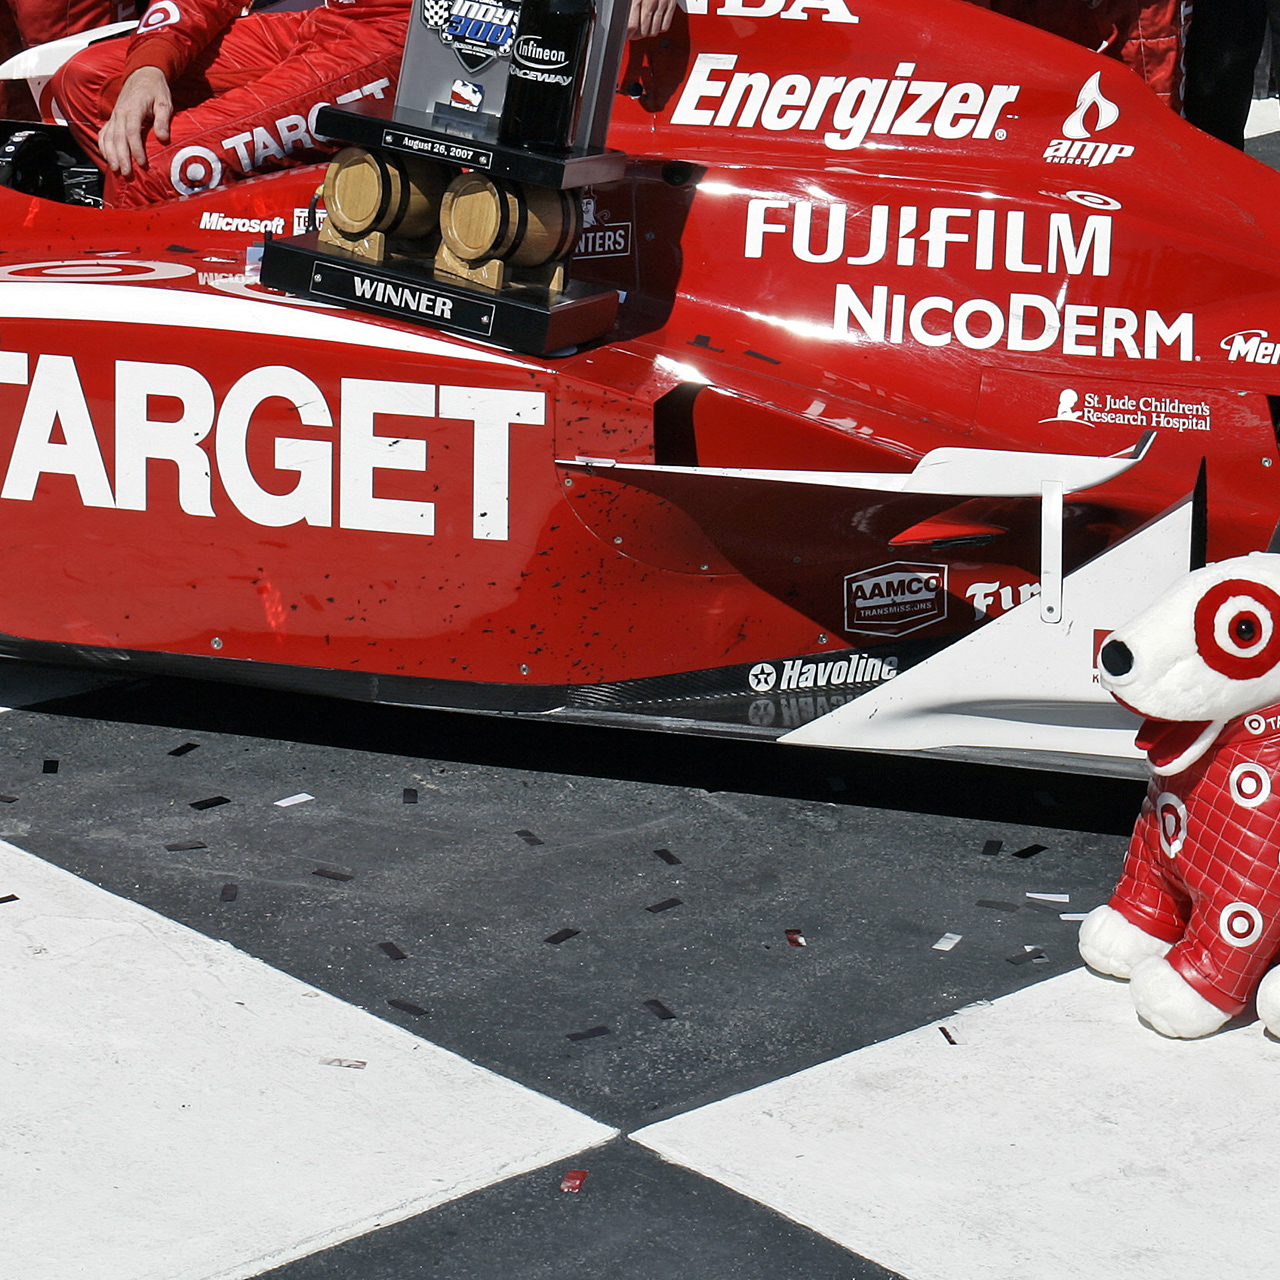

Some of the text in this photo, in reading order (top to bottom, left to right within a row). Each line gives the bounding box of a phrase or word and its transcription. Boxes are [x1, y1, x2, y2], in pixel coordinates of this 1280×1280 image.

[446, 15, 515, 45] 300
[519, 39, 566, 62] Infineon
[509, 64, 573, 86] RACEWAY
[670, 53, 1020, 150] Energizer
[402, 135, 474, 161] August 26, 2007
[200, 211, 285, 235] Microsoft
[744, 200, 1113, 277] FUJIFILM
[352, 276, 453, 321] WINNER
[830, 283, 1194, 362] NICODERM
[1084, 392, 1210, 417] St. Jude Children's
[1083, 407, 1210, 432] Research Hospital
[853, 576, 940, 602] AAMCO
[860, 602, 932, 620] TRANSMISSIONS
[781, 654, 899, 690] Havoline
